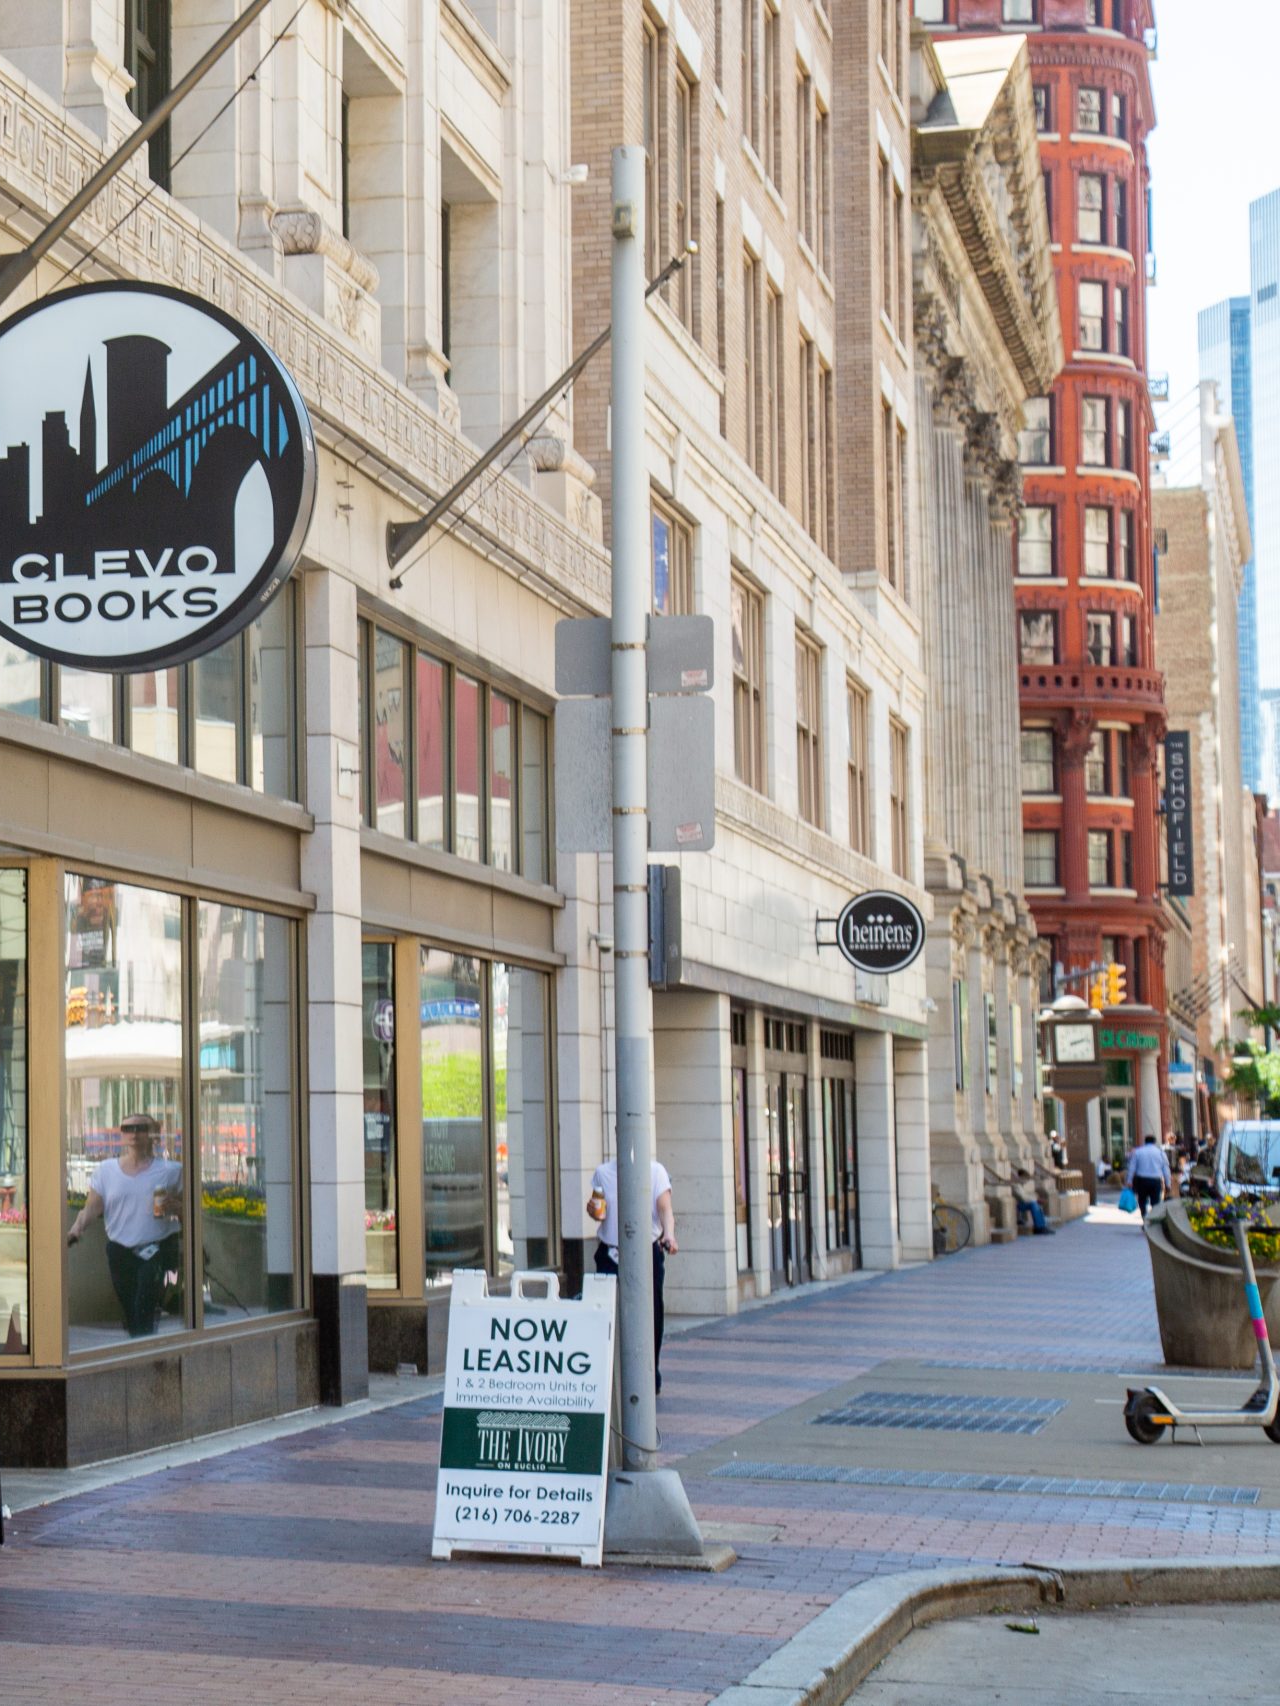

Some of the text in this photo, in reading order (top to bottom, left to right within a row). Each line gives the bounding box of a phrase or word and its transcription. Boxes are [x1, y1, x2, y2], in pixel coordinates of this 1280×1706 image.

[12, 545, 218, 585] CLEVO
[13, 587, 218, 625] BOOKS
[1171, 752, 1187, 885] SCHOFIELD
[490, 1318, 568, 1342] NOW
[463, 1348, 591, 1375] LEASING
[465, 1378, 475, 1388] &
[478, 1378, 486, 1389] 2
[489, 1378, 544, 1391] Bedroom
[549, 1381, 578, 1392] Units
[581, 1381, 598, 1393] for
[456, 1393, 595, 1409] Immediate Availability
[478, 1427, 569, 1464] THE IVORY
[497, 1462, 546, 1471] ON EUCLID
[446, 1482, 593, 1502] Inquire for Details
[455, 1506, 580, 1525] (216) 706-2287
